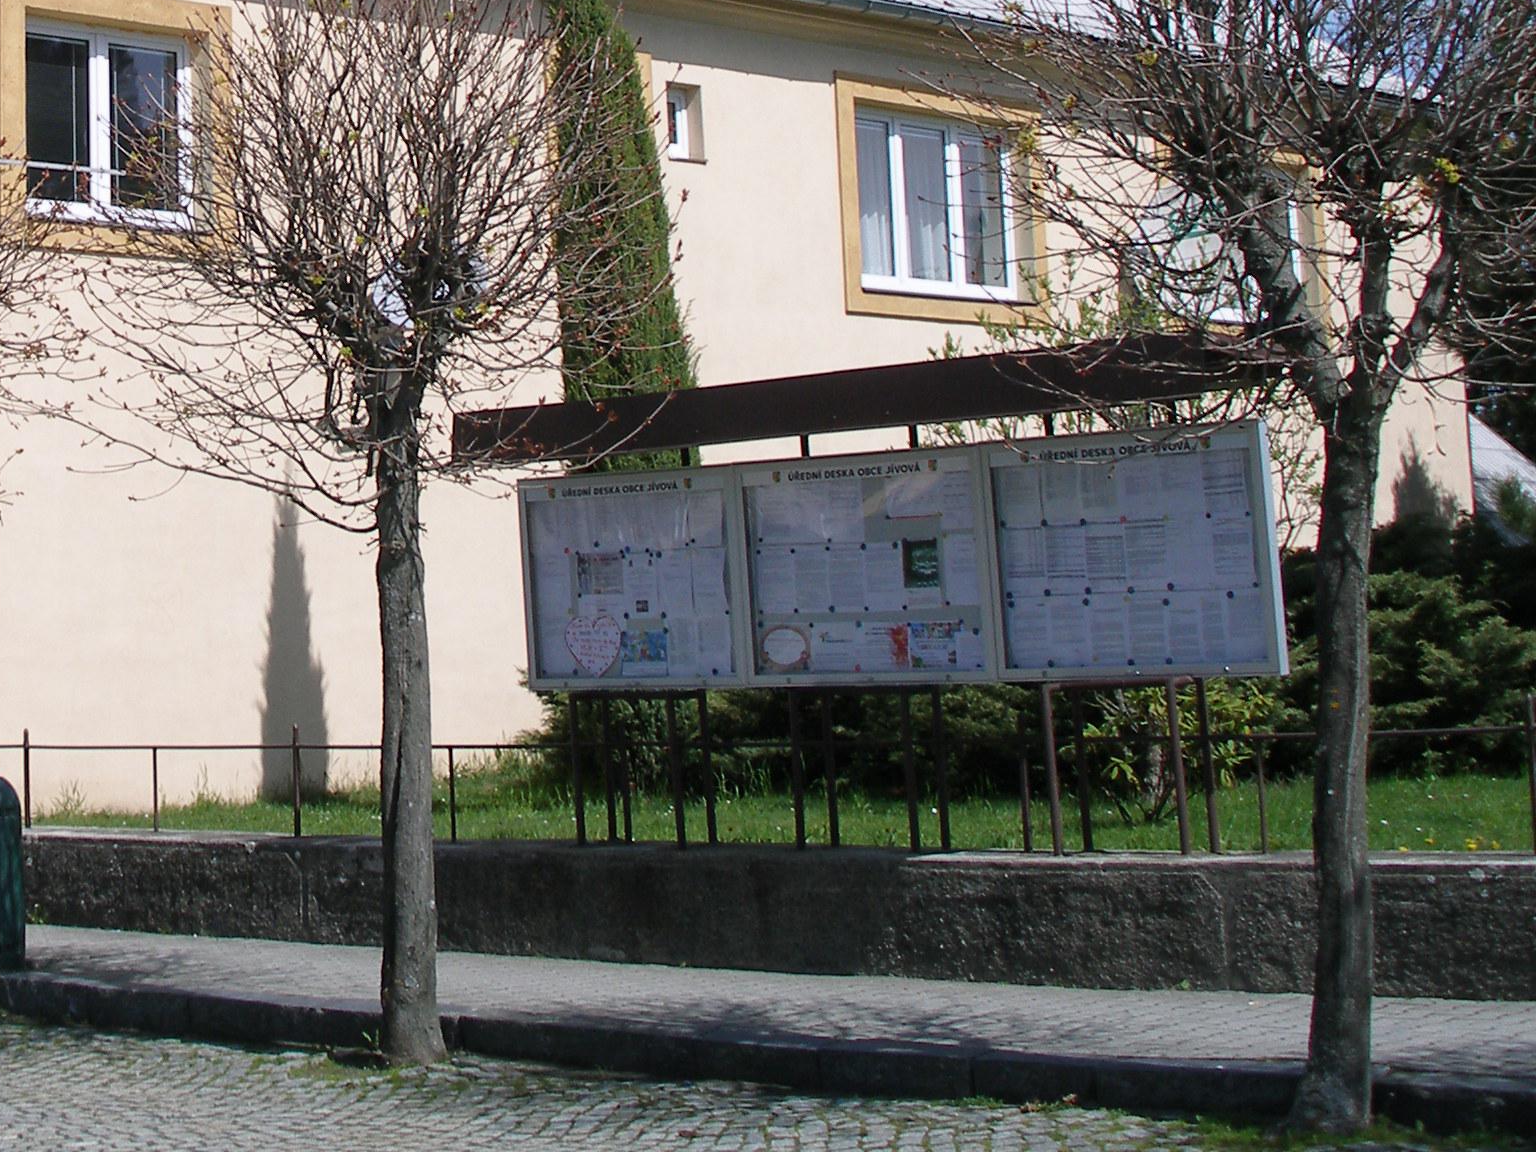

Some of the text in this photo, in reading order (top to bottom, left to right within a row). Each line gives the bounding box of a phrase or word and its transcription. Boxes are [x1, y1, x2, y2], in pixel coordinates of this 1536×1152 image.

[787, 461, 921, 482] ÚŘEDNÍ DESKA OBCE JÍVOVÁ
[593, 485, 621, 496] DESKA
[622, 483, 644, 494] OBCE
